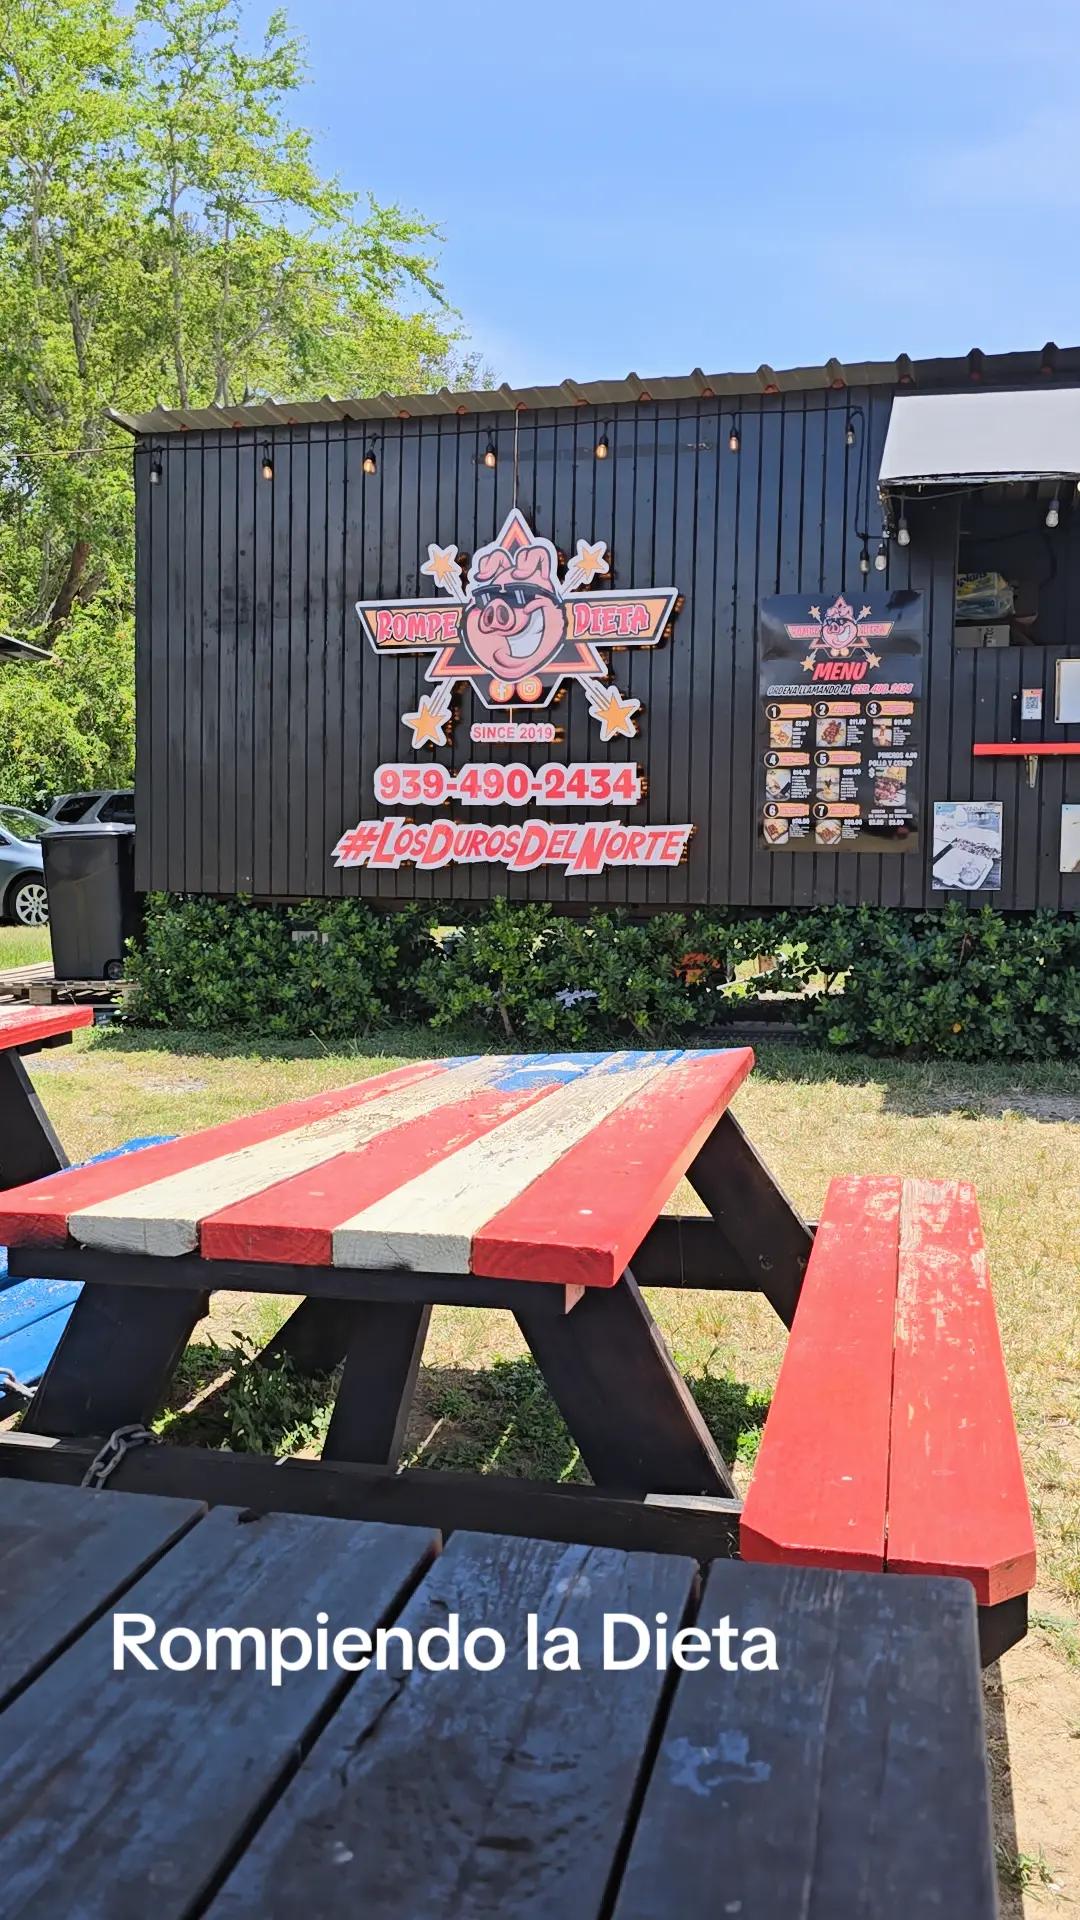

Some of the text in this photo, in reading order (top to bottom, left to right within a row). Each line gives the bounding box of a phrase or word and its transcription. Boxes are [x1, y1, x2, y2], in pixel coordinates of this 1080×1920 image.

[376, 602, 650, 644] ROMPE DIETA
[812, 661, 868, 681] MENU
[770, 706, 777, 718] 1
[819, 704, 826, 716] 2
[869, 703, 877, 714] 3
[472, 725, 553, 741] SINCE 2019
[769, 754, 776, 766] 4
[819, 753, 827, 765] 5
[379, 767, 637, 800] 939-490-2434
[769, 805, 776, 816] 6
[818, 805, 825, 817] 7
